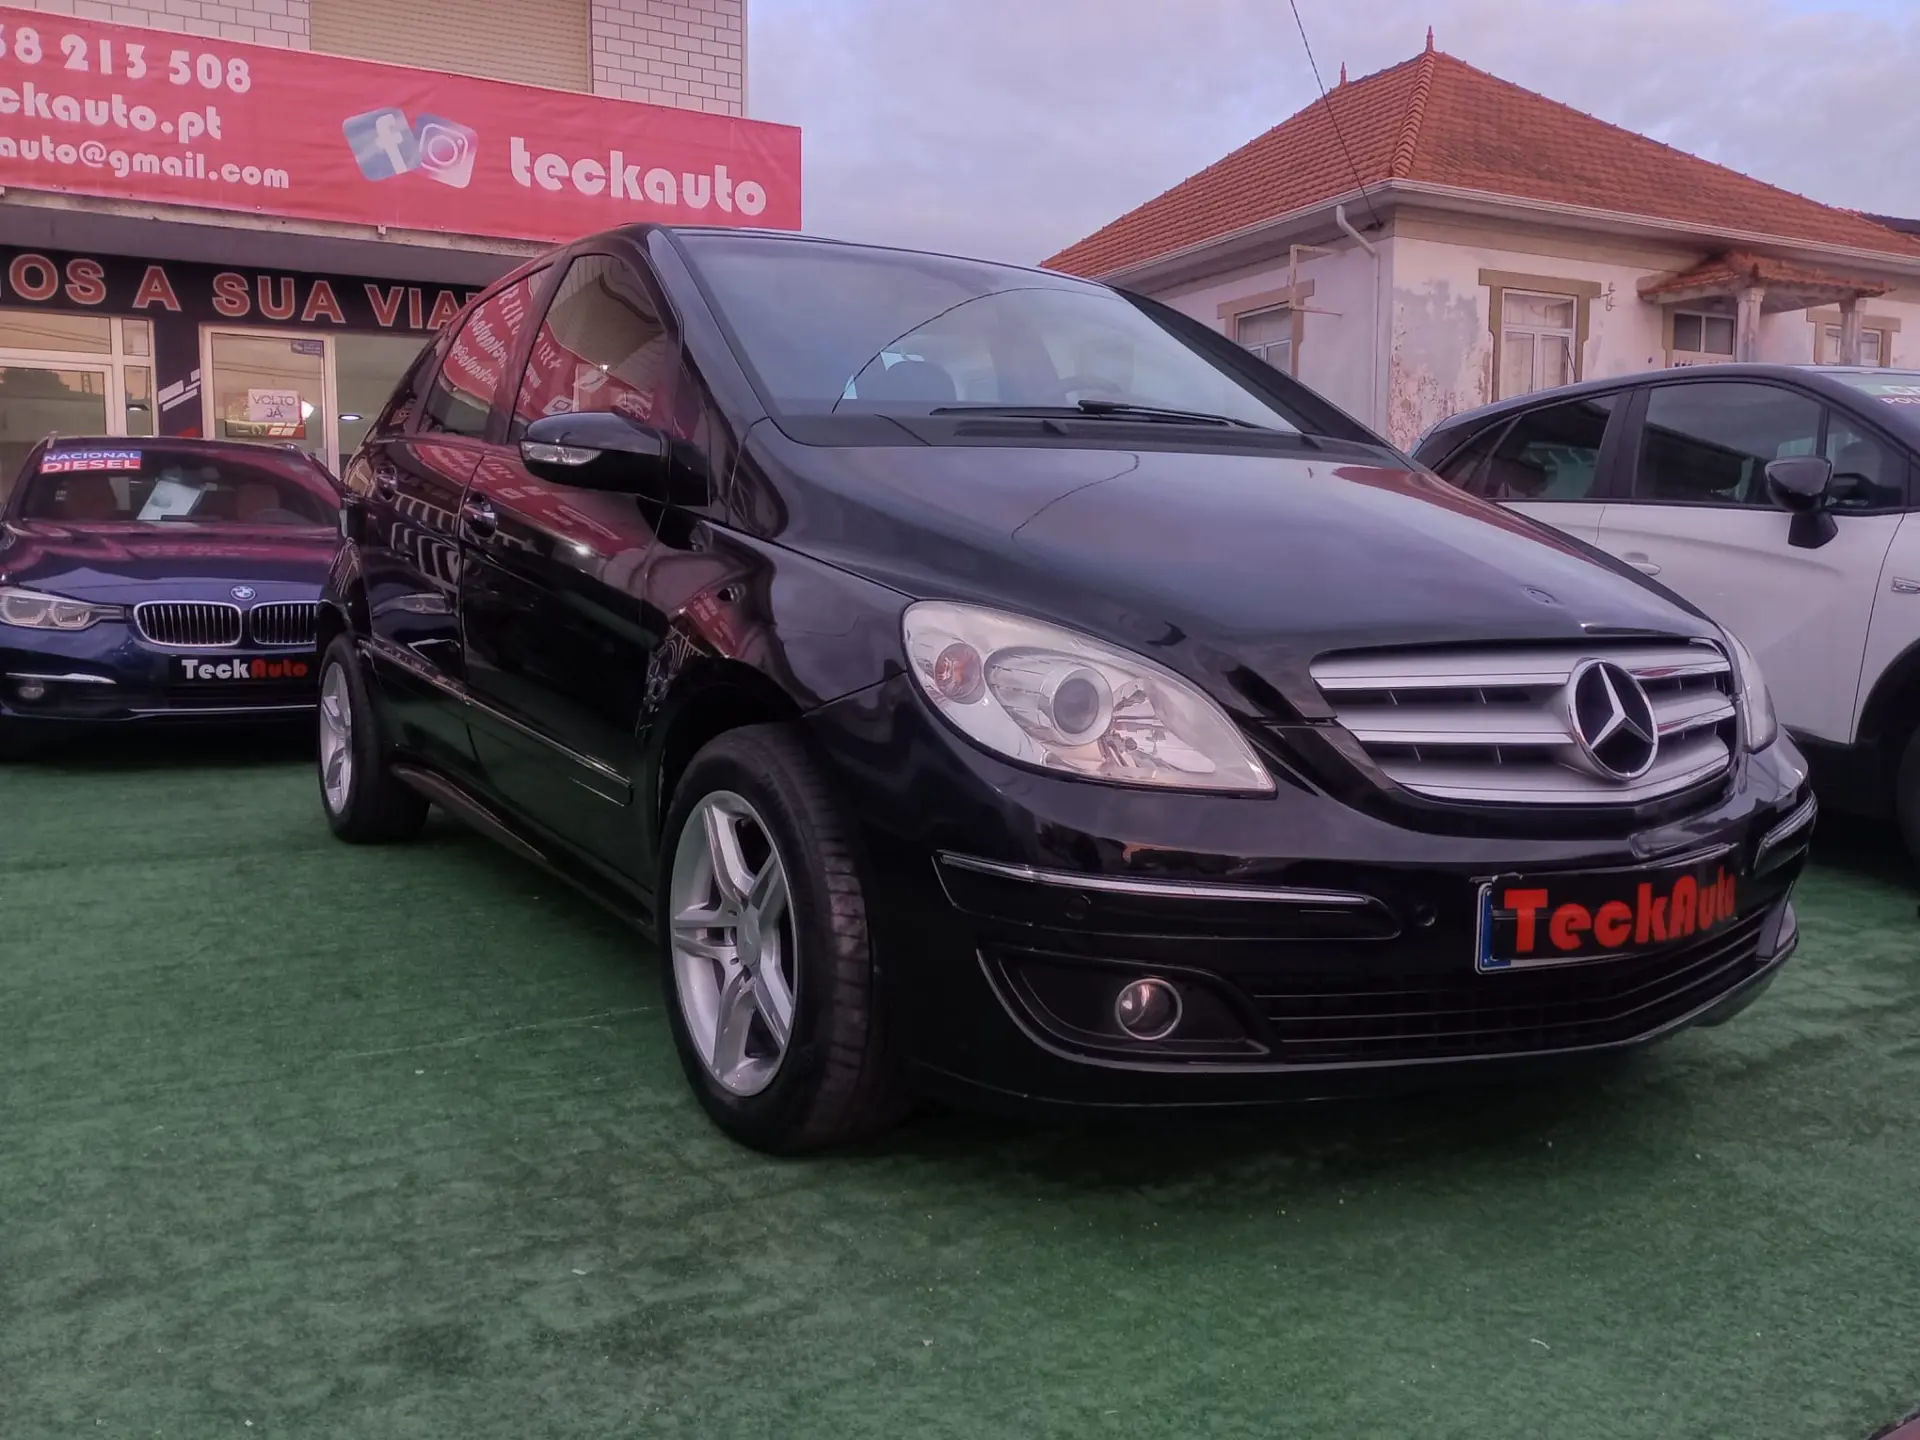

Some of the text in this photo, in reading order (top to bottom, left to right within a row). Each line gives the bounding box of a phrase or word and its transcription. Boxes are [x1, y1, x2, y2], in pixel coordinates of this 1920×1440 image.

[0, 23, 252, 94] 8 213 508
[0, 81, 223, 144] ckauto.pt
[0, 134, 290, 189] auto@gmail.com
[509, 136, 768, 217] teckauto
[132, 265, 183, 312] A
[211, 272, 346, 324] SUA
[363, 283, 481, 330] VIA
[251, 394, 296, 407] VOLTO
[41, 459, 141, 474] DIESEL
[43, 451, 139, 462] NACIONAL
